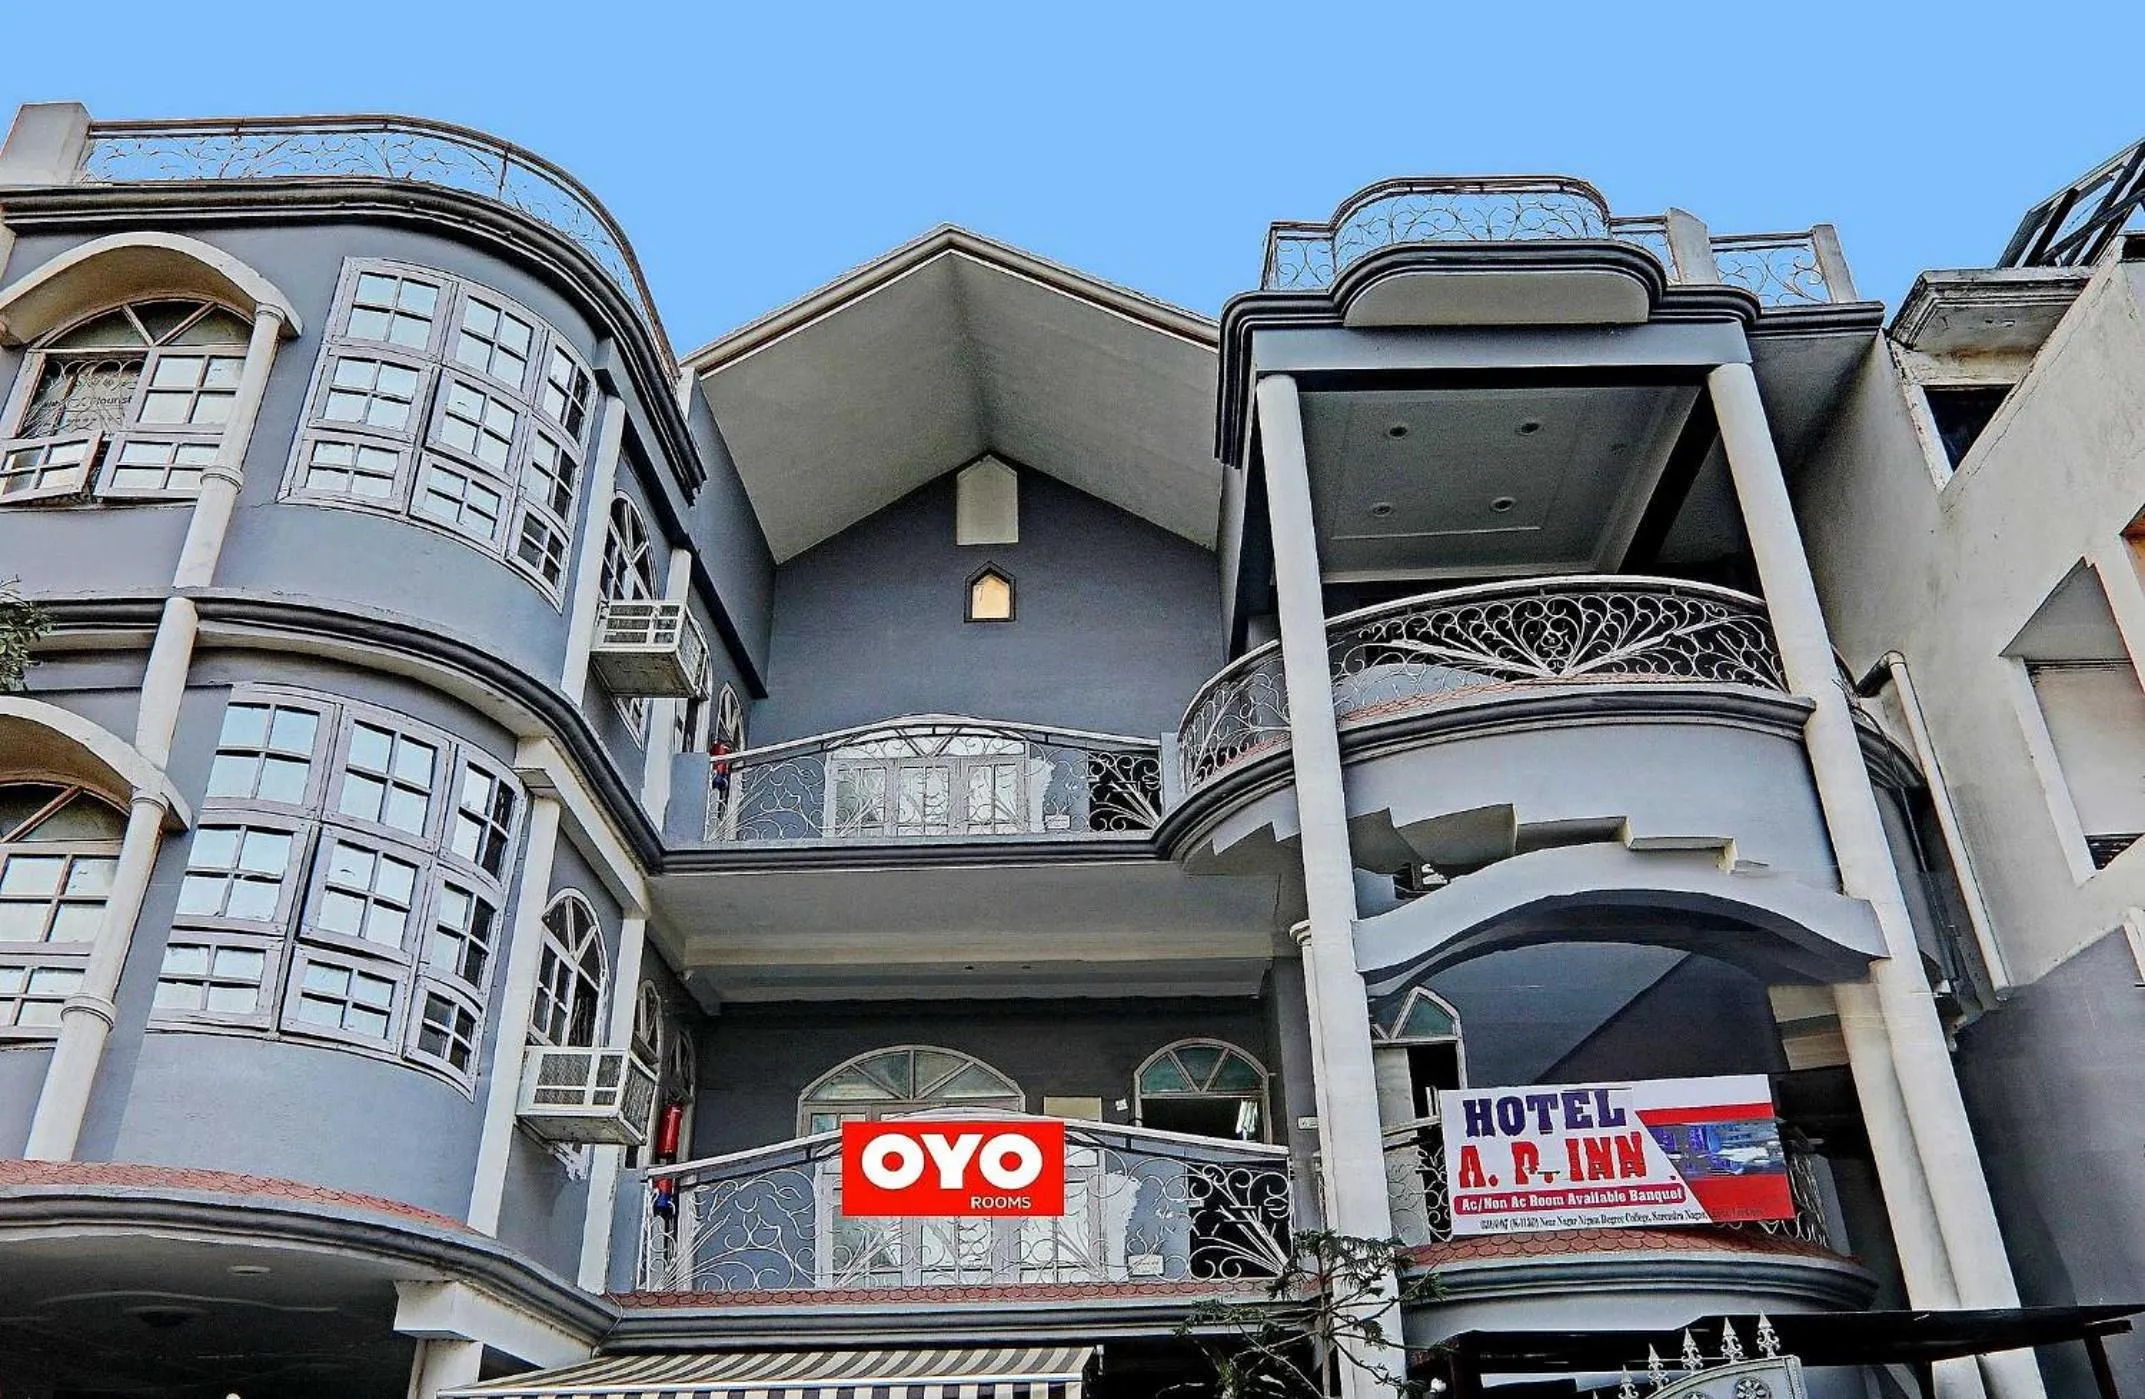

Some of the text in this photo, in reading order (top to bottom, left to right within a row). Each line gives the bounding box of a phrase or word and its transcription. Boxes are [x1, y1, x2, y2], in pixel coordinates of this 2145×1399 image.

[1462, 1089, 1627, 1137] HOTEL
[861, 1132, 1043, 1190] OYO
[1459, 1145, 1499, 1188] A.
[1565, 1131, 1647, 1182] INN
[970, 1196, 1031, 1209] ROOMS
[1511, 1195, 1526, 1208] Ac
[1530, 1193, 1564, 1207] Room
[1568, 1190, 1626, 1205] Available
[1629, 1187, 1682, 1204] Banquet
